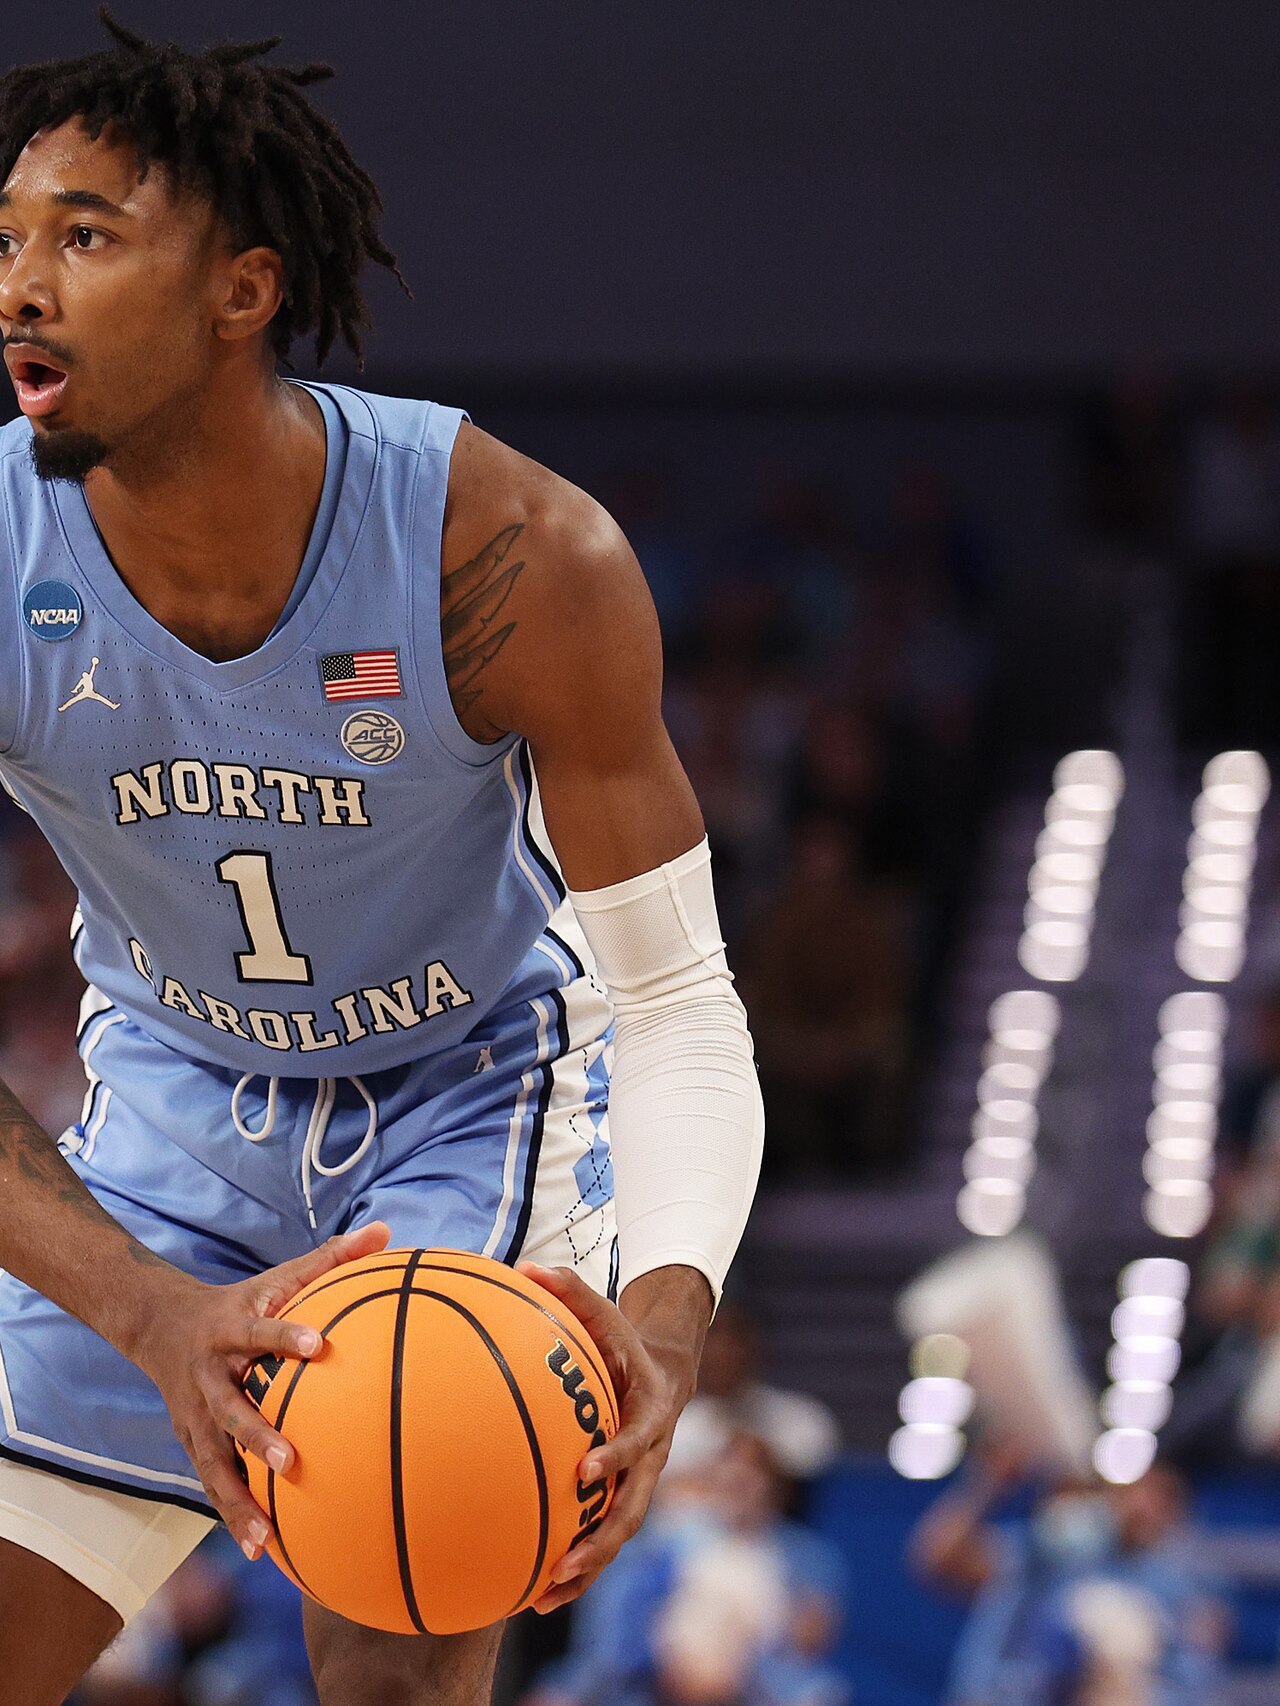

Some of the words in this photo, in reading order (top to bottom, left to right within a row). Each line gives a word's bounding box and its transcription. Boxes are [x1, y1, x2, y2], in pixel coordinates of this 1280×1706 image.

[31, 609, 78, 625] NCAA
[352, 728, 397, 742] ACC
[111, 758, 372, 827] NORTH
[215, 850, 314, 986] 1
[128, 937, 474, 1052] CAROLINA
